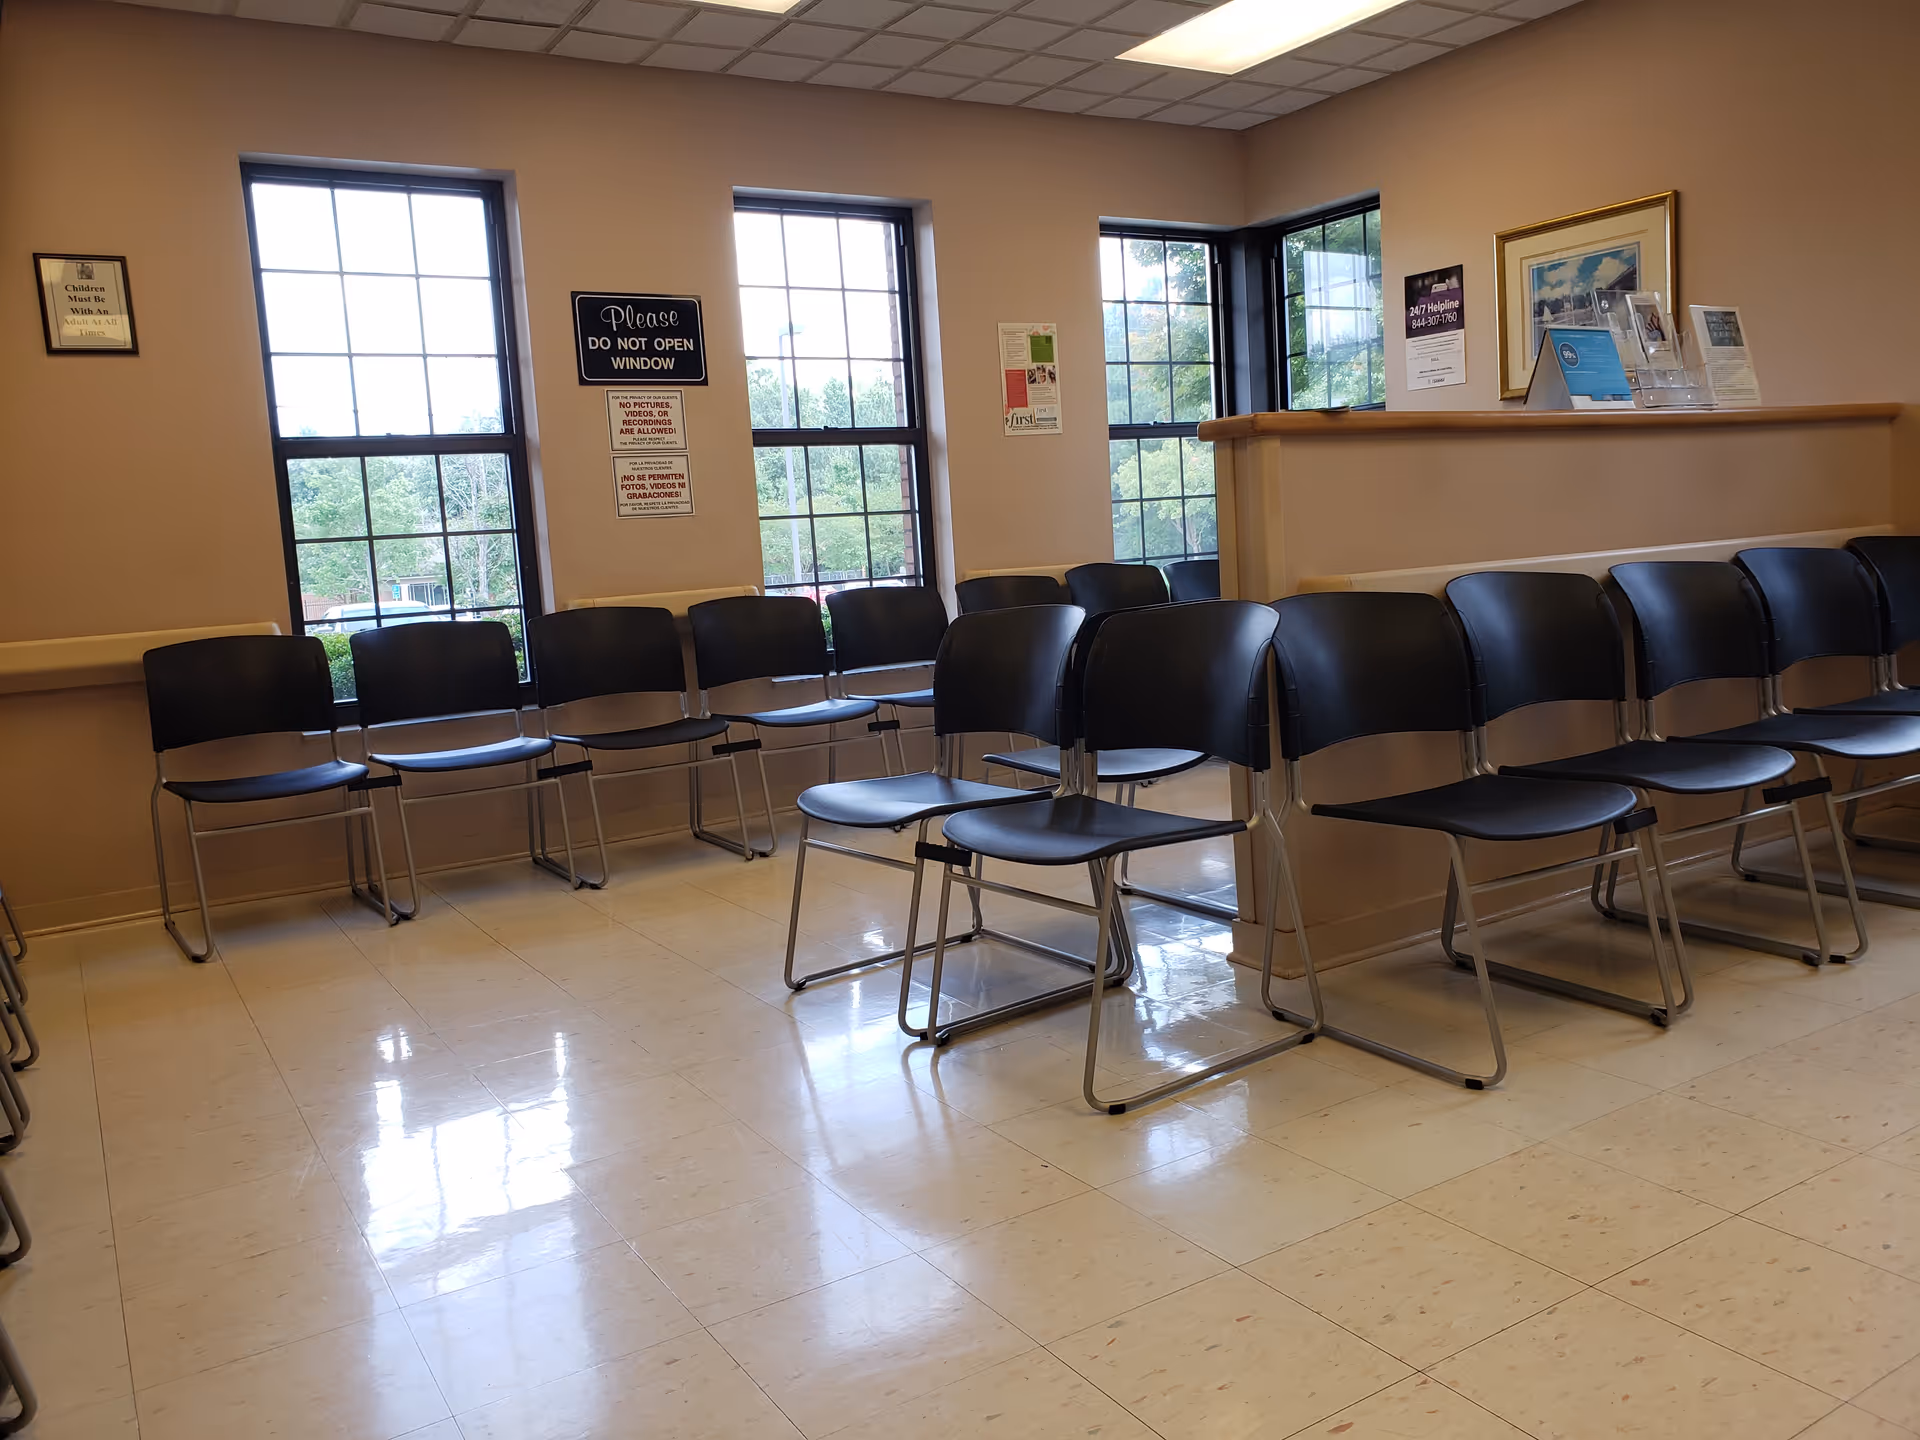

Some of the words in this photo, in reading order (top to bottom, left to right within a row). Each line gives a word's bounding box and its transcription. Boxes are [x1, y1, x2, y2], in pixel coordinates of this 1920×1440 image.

[65, 284, 106, 292] Children
[1410, 304, 1426, 316] 24/7
[1428, 299, 1460, 313] Helpline
[600, 304, 679, 332] Please
[1412, 312, 1458, 329] 844-307-1760
[80, 328, 106, 336] Times
[588, 336, 611, 350] DO
[618, 338, 647, 350] NOT
[654, 338, 694, 351] OPEN
[611, 357, 675, 370] WINDOW
[1009, 412, 1034, 428] first
[626, 491, 682, 500] GRABACIONES!
